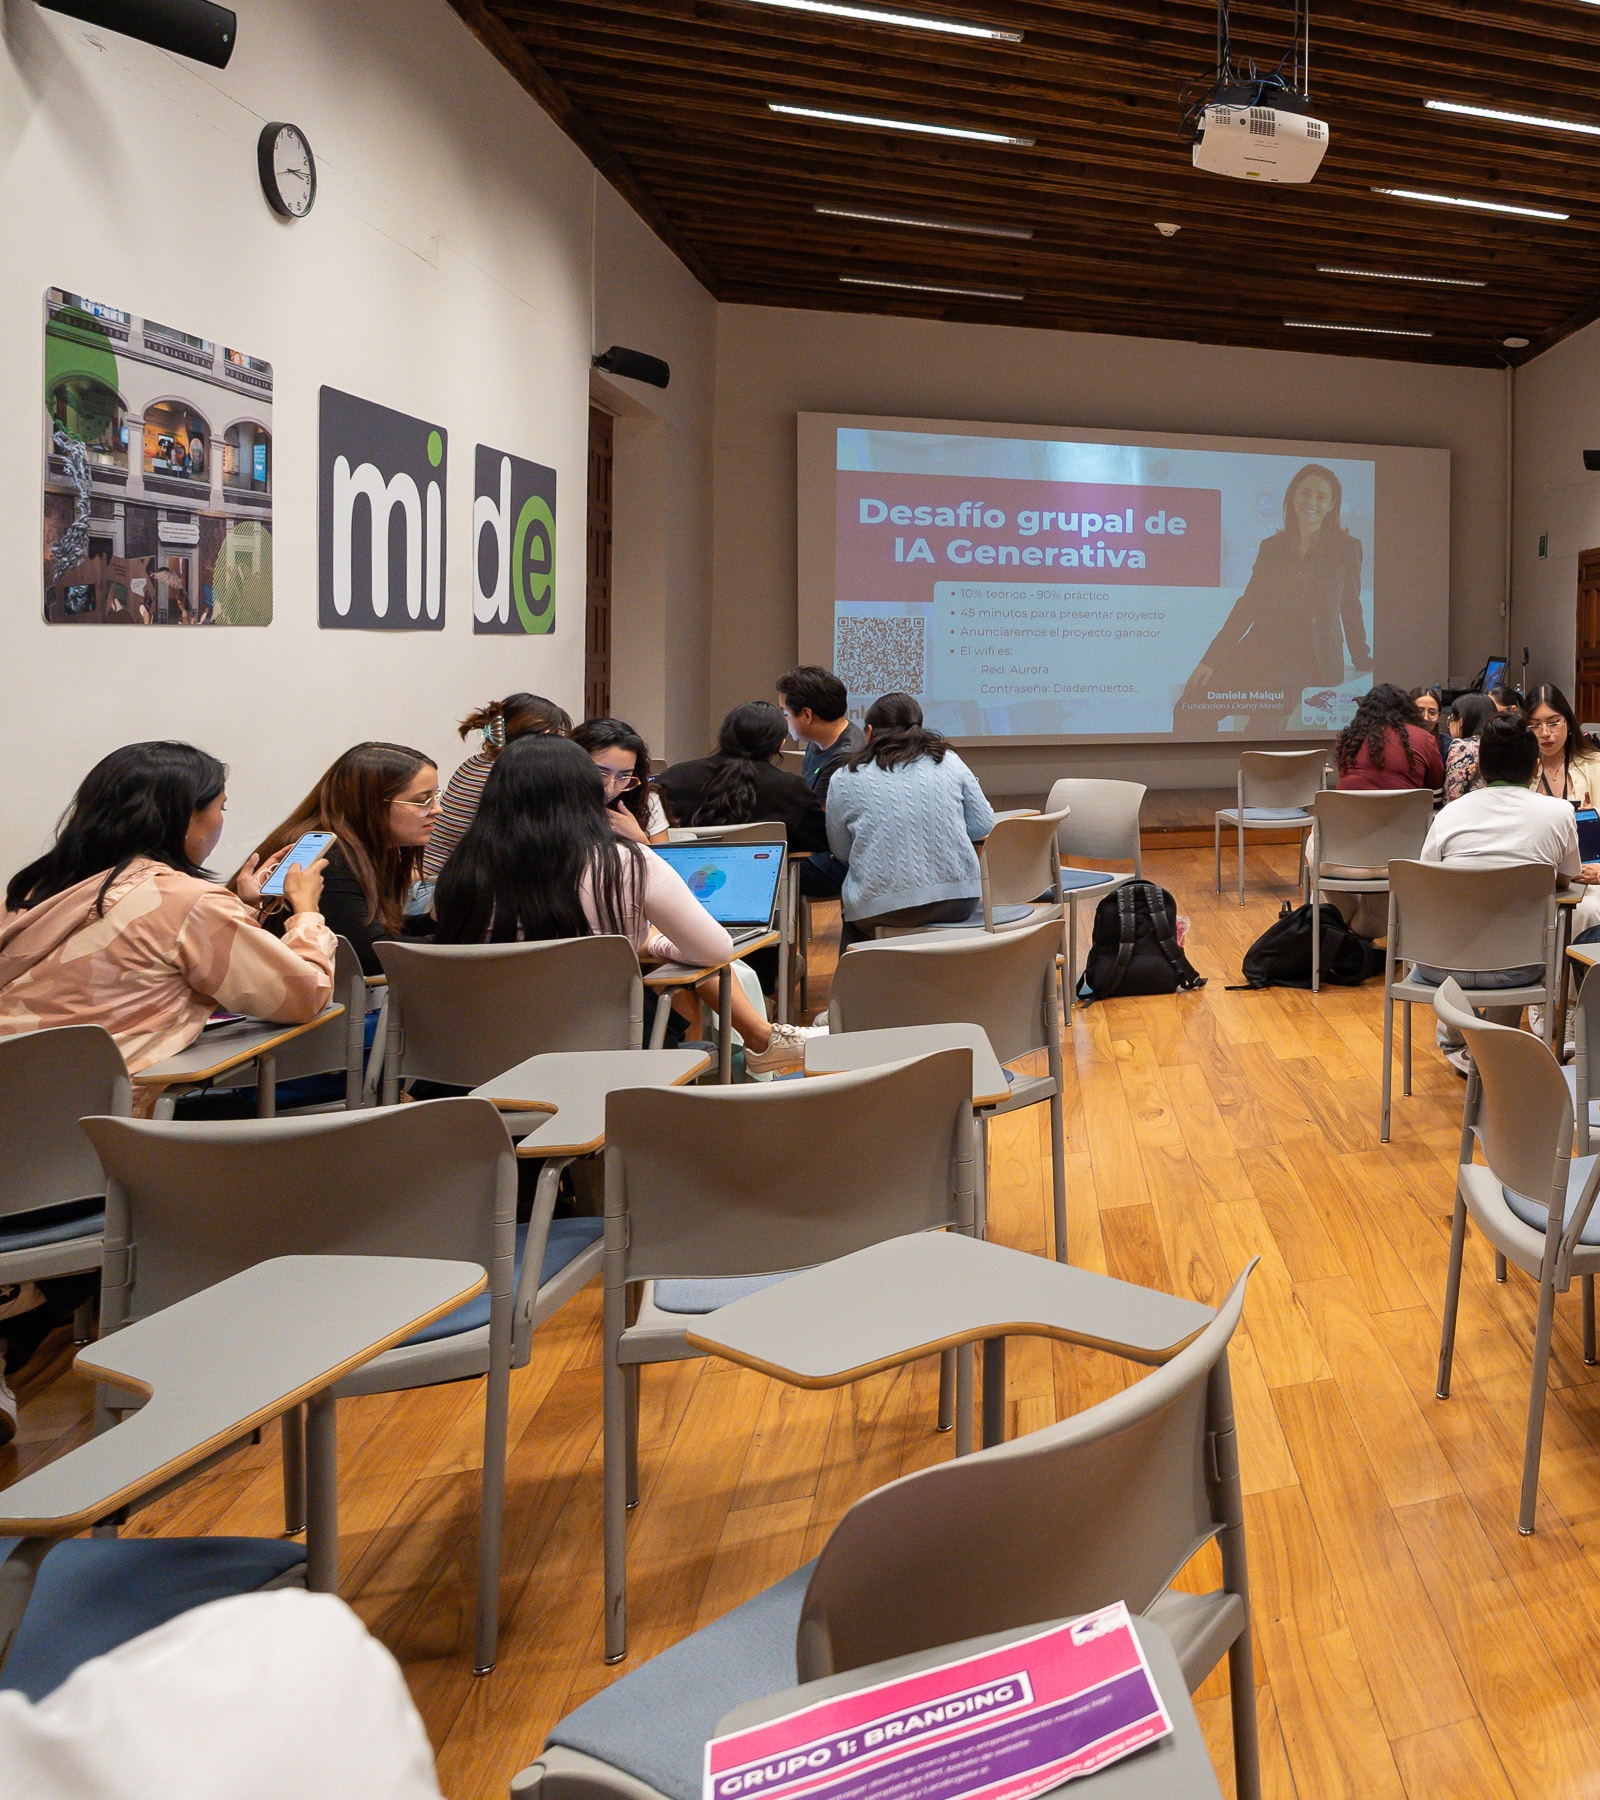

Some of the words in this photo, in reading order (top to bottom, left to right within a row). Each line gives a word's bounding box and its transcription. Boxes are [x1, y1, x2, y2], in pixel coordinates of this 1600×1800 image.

[859, 498, 1006, 528] Desafío
[1016, 508, 1134, 538] grupal
[1144, 510, 1188, 536] de
[894, 537, 936, 564] IA
[946, 538, 1147, 569] Generativa
[960, 589, 983, 600] 10%
[986, 589, 1027, 600] teórico
[1037, 590, 1061, 600] 90%
[1064, 590, 1110, 603] práctico
[960, 608, 975, 618] 45
[978, 608, 1028, 618] minutos
[1030, 610, 1056, 621] para
[1059, 610, 1114, 622] presentar
[1116, 611, 1165, 623] proyecto
[960, 627, 1047, 637] Anunciaremos
[1049, 627, 1059, 637] el
[1062, 628, 1112, 640] proyecto
[1115, 628, 1162, 640] ganador
[960, 646, 971, 656] El
[973, 646, 995, 656] wifi
[998, 648, 1013, 656] es:
[981, 664, 1007, 674] Red:
[1010, 664, 1049, 674] Aurora
[980, 683, 1051, 694] Contraseña:
[1207, 690, 1247, 700] Daniela
[1249, 690, 1284, 701] Malqui
[1181, 702, 1230, 710] Fundadora
[1231, 702, 1257, 711] Doing
[1258, 702, 1285, 710] Minds
[719, 1747, 832, 1796] GRUPO
[836, 1738, 858, 1757] 1:
[863, 1685, 1014, 1748] BRANDING
